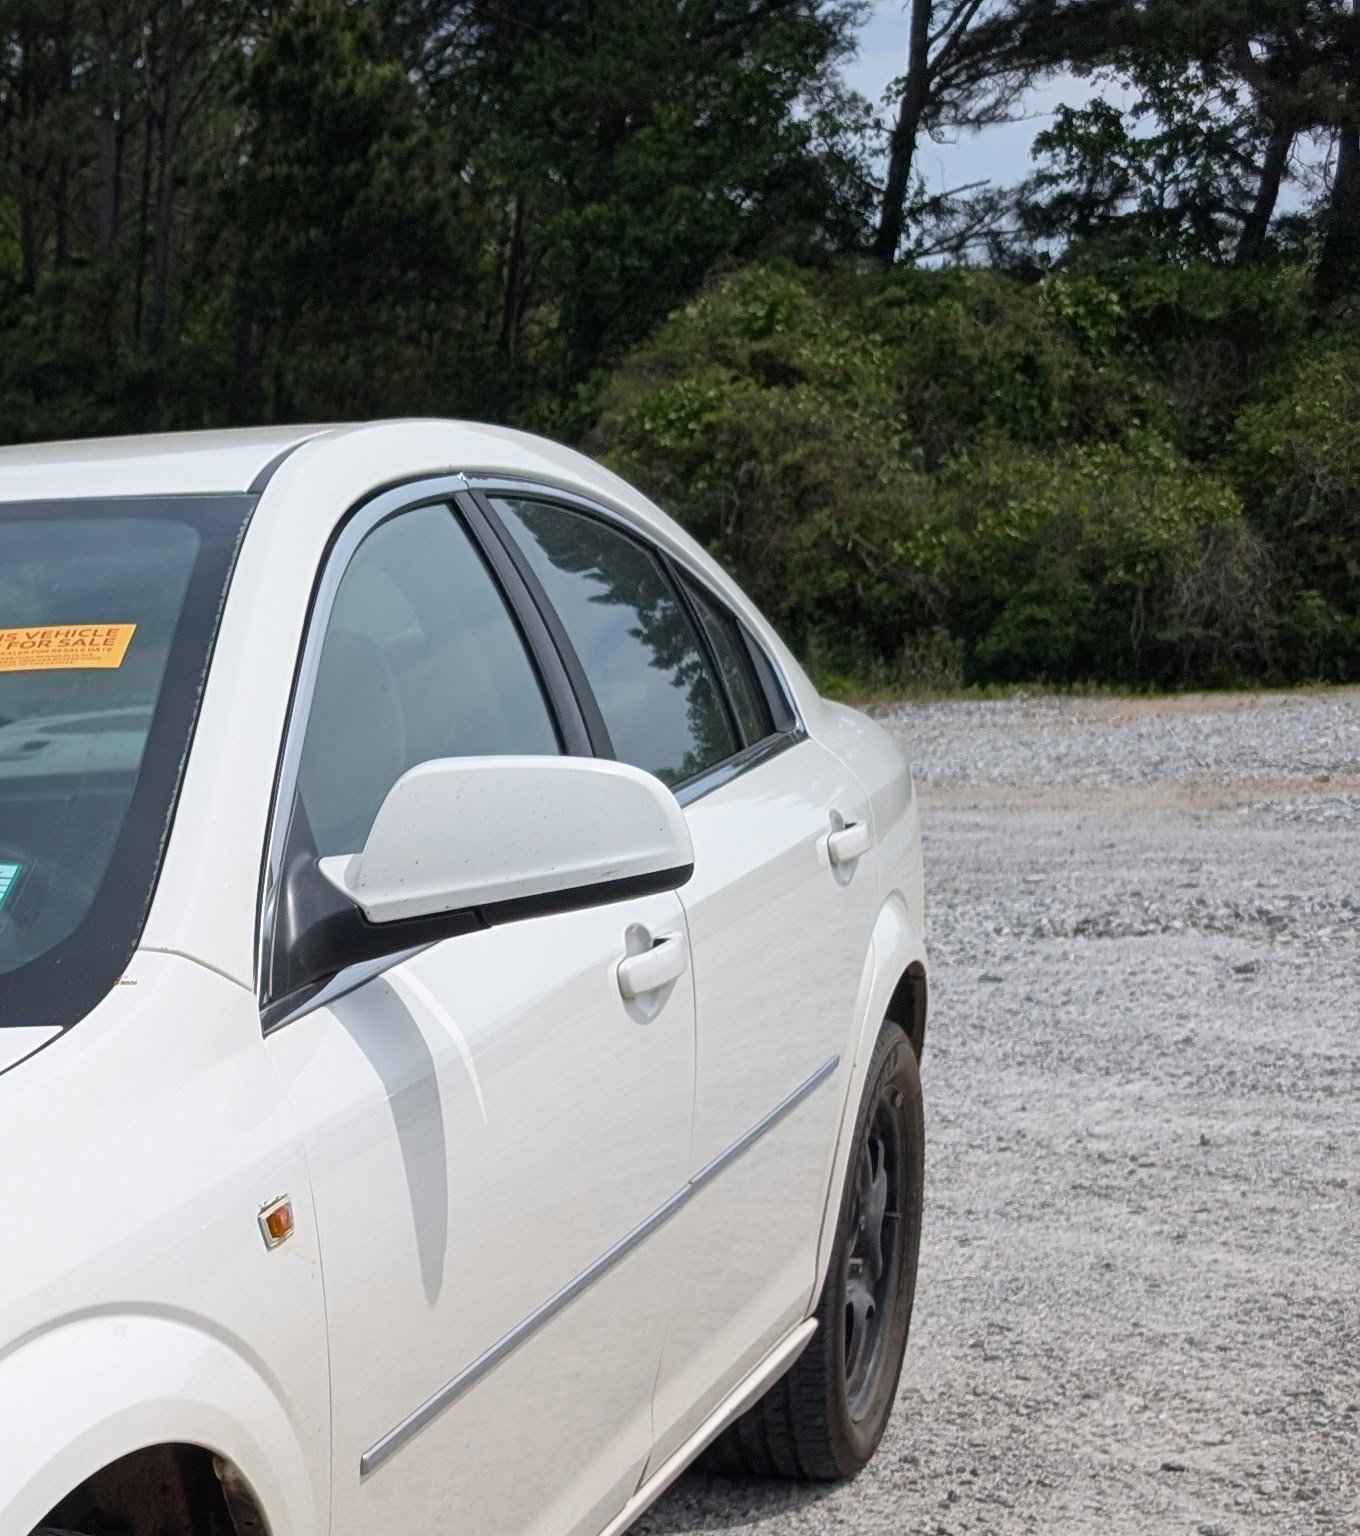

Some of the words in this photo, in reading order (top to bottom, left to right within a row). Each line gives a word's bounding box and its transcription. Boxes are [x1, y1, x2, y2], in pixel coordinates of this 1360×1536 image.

[24, 627, 121, 641] VEHICLE
[4, 640, 53, 650] FOR
[57, 637, 116, 648] SALE
[50, 647, 86, 655] RESALE
